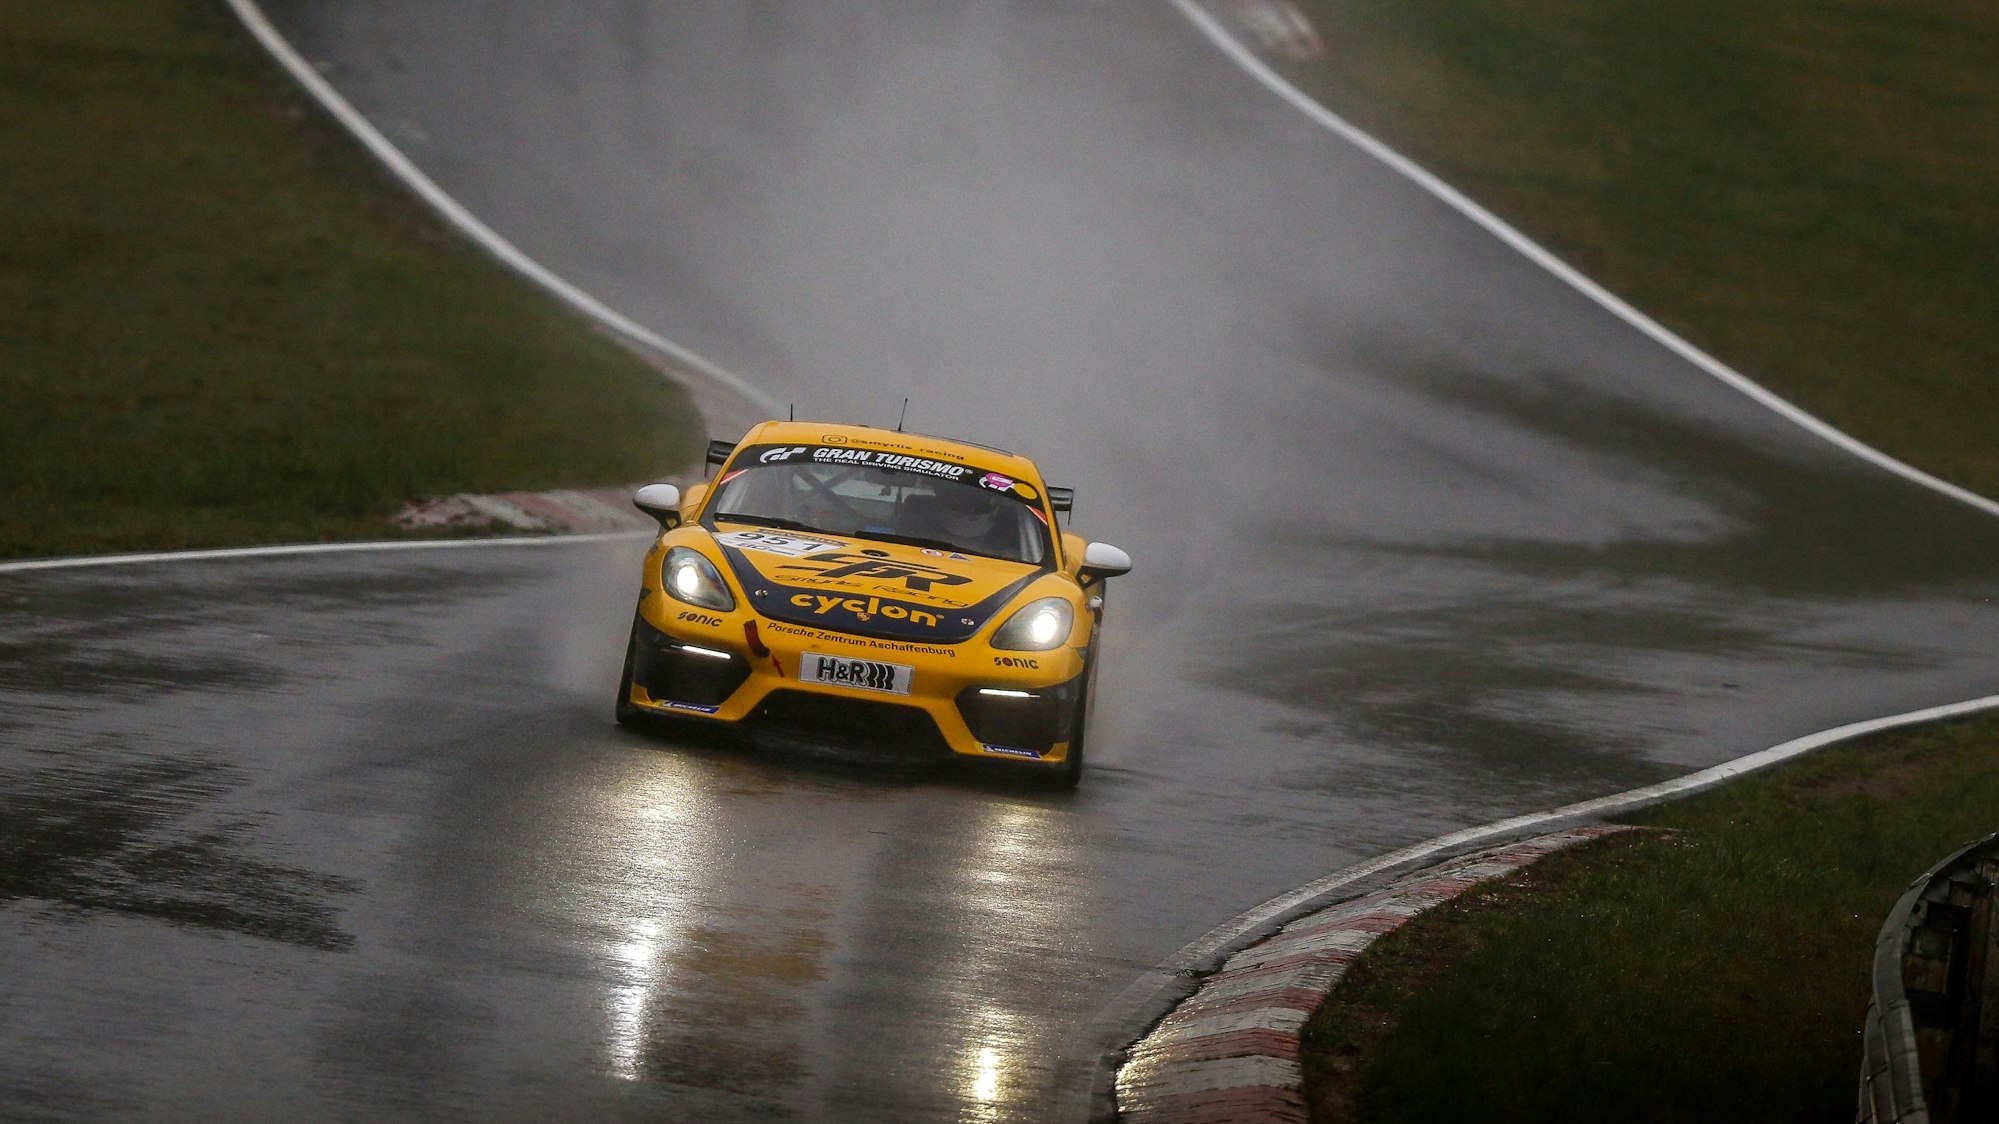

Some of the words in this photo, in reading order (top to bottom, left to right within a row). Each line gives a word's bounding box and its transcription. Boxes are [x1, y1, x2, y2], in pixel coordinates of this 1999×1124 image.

[813, 448, 871, 461] GRAN
[862, 461, 902, 470] DRIVING
[903, 466, 959, 481] SIMULATOR
[790, 594, 938, 627] cyclon
[767, 622, 814, 638] Porsche
[816, 631, 866, 647] Zentrum
[868, 640, 956, 657] Aschaffenburg
